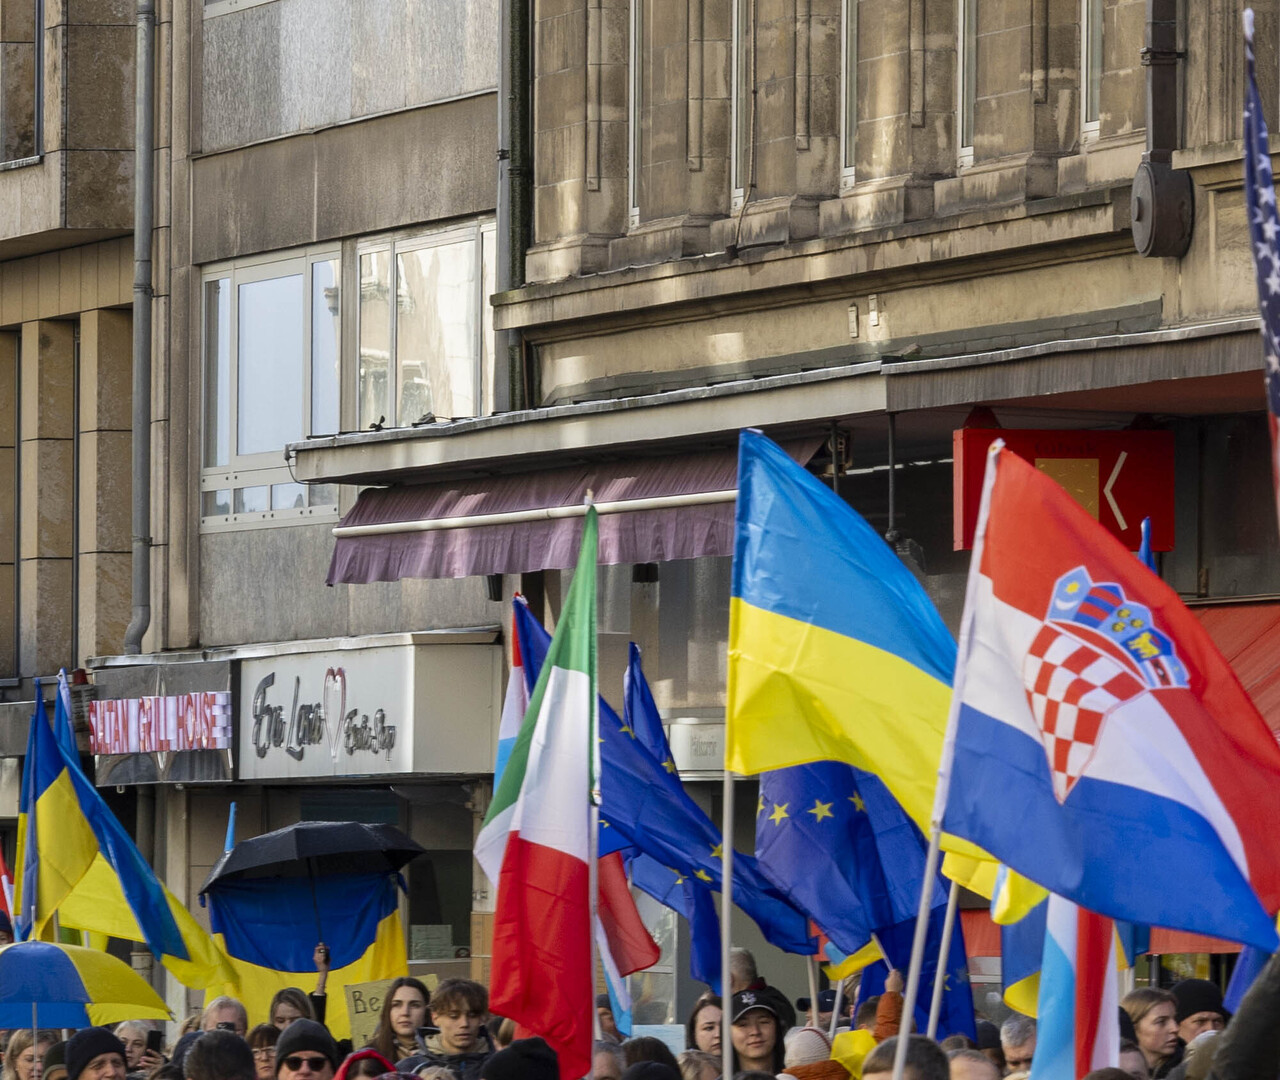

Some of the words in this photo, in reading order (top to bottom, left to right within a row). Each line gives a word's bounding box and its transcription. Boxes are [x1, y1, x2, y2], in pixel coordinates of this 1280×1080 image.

[89, 698, 131, 756] SULTAN
[139, 694, 173, 754] GRILL
[176, 691, 225, 750] HOUSE
